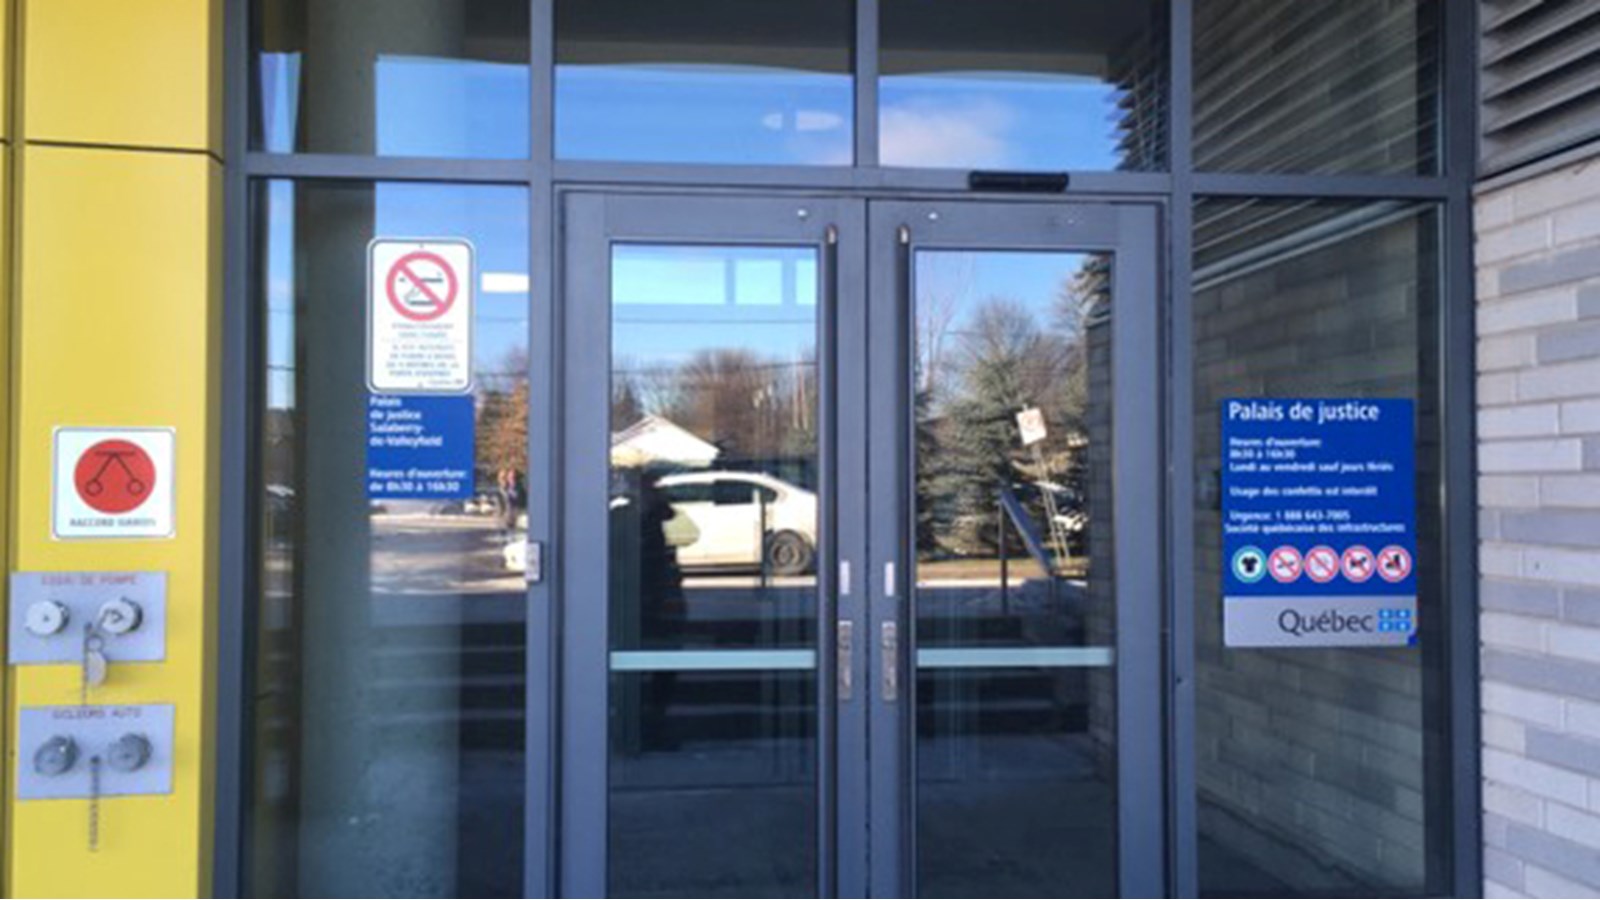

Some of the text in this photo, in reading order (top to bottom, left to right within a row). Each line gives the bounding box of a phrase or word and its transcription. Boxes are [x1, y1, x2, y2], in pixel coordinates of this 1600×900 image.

[369, 396, 402, 407] Palais
[369, 409, 422, 421] de justice
[1229, 401, 1380, 424] Palais de justice
[369, 481, 384, 491] de
[1278, 608, 1374, 637] Québec
